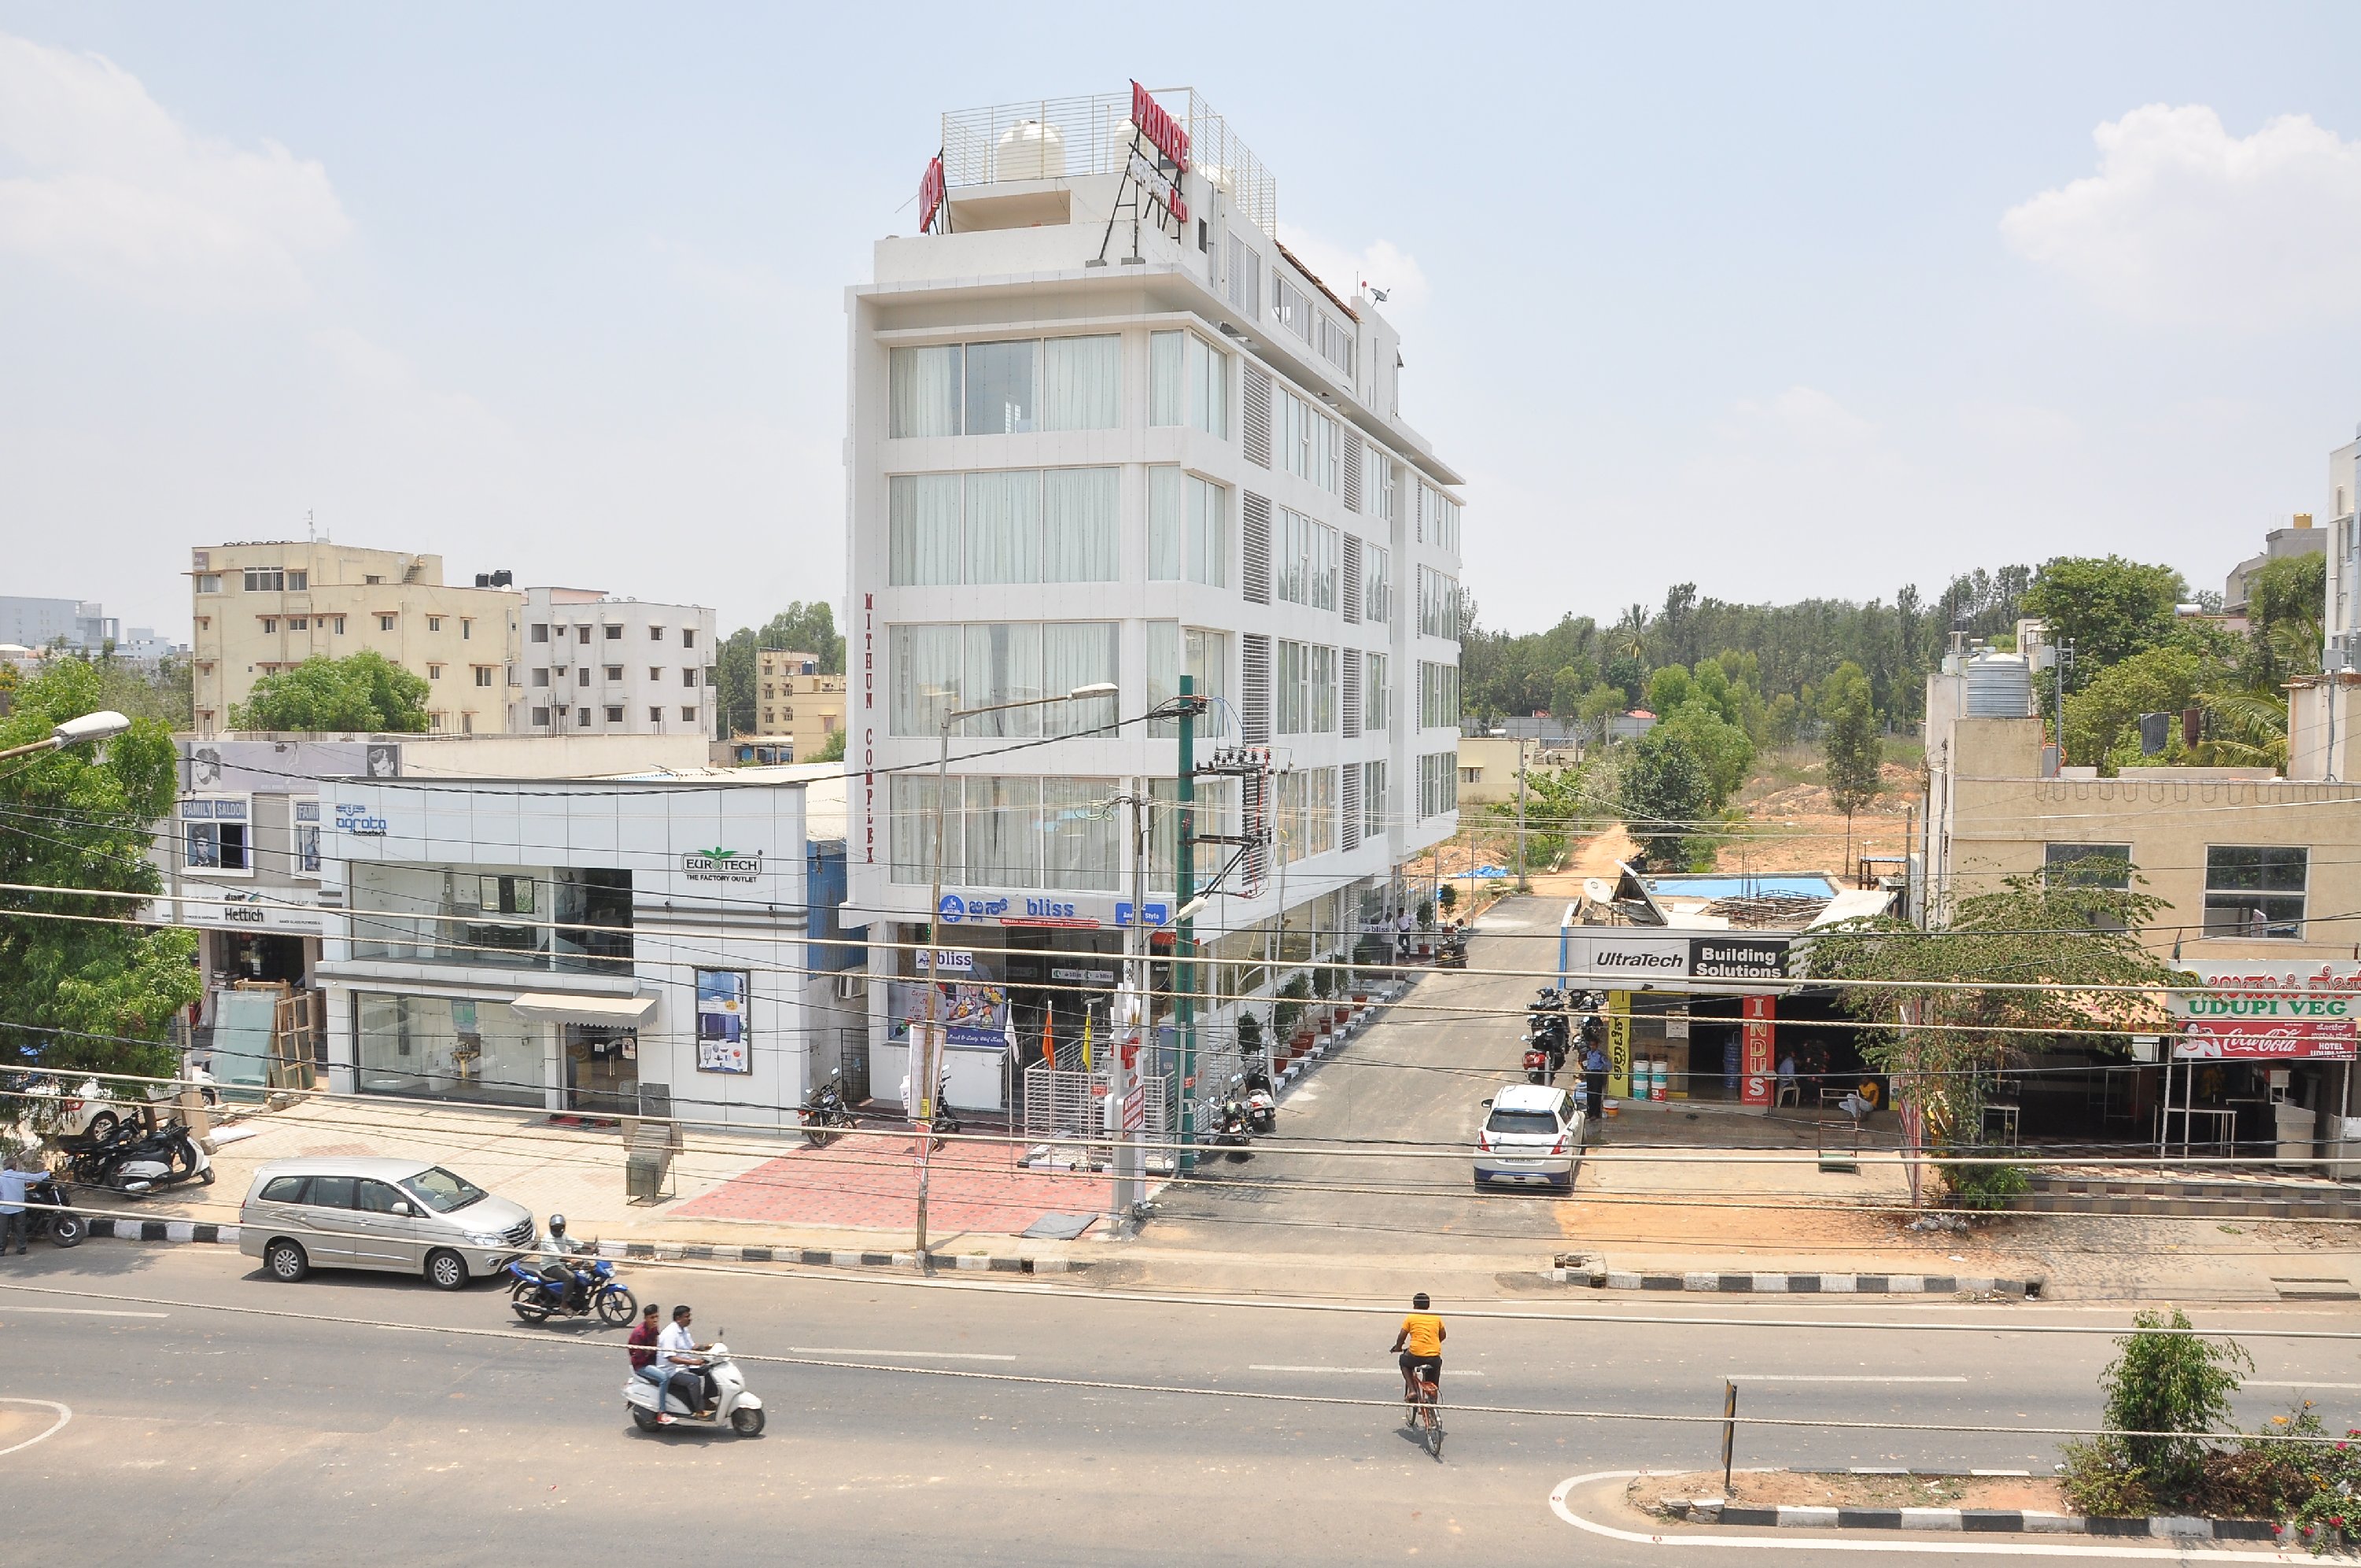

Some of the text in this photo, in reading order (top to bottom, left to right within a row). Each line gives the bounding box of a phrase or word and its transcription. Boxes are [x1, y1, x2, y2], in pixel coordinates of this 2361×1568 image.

[1132, 82, 1189, 174] PRINCE
[183, 802, 246, 817] FAMILY SALOON
[297, 805, 319, 819] FAMI
[686, 858, 757, 871] EUROTECH
[224, 907, 264, 922] Hettich
[1026, 898, 1075, 917] bliss
[937, 951, 972, 966] bliss
[1596, 951, 1684, 968] UltraTech
[1702, 947, 1776, 965] Building
[1695, 962, 1782, 979] Solutions
[2188, 1000, 2348, 1016] UDUPI VEG
[1748, 998, 1767, 1096] INDUS
